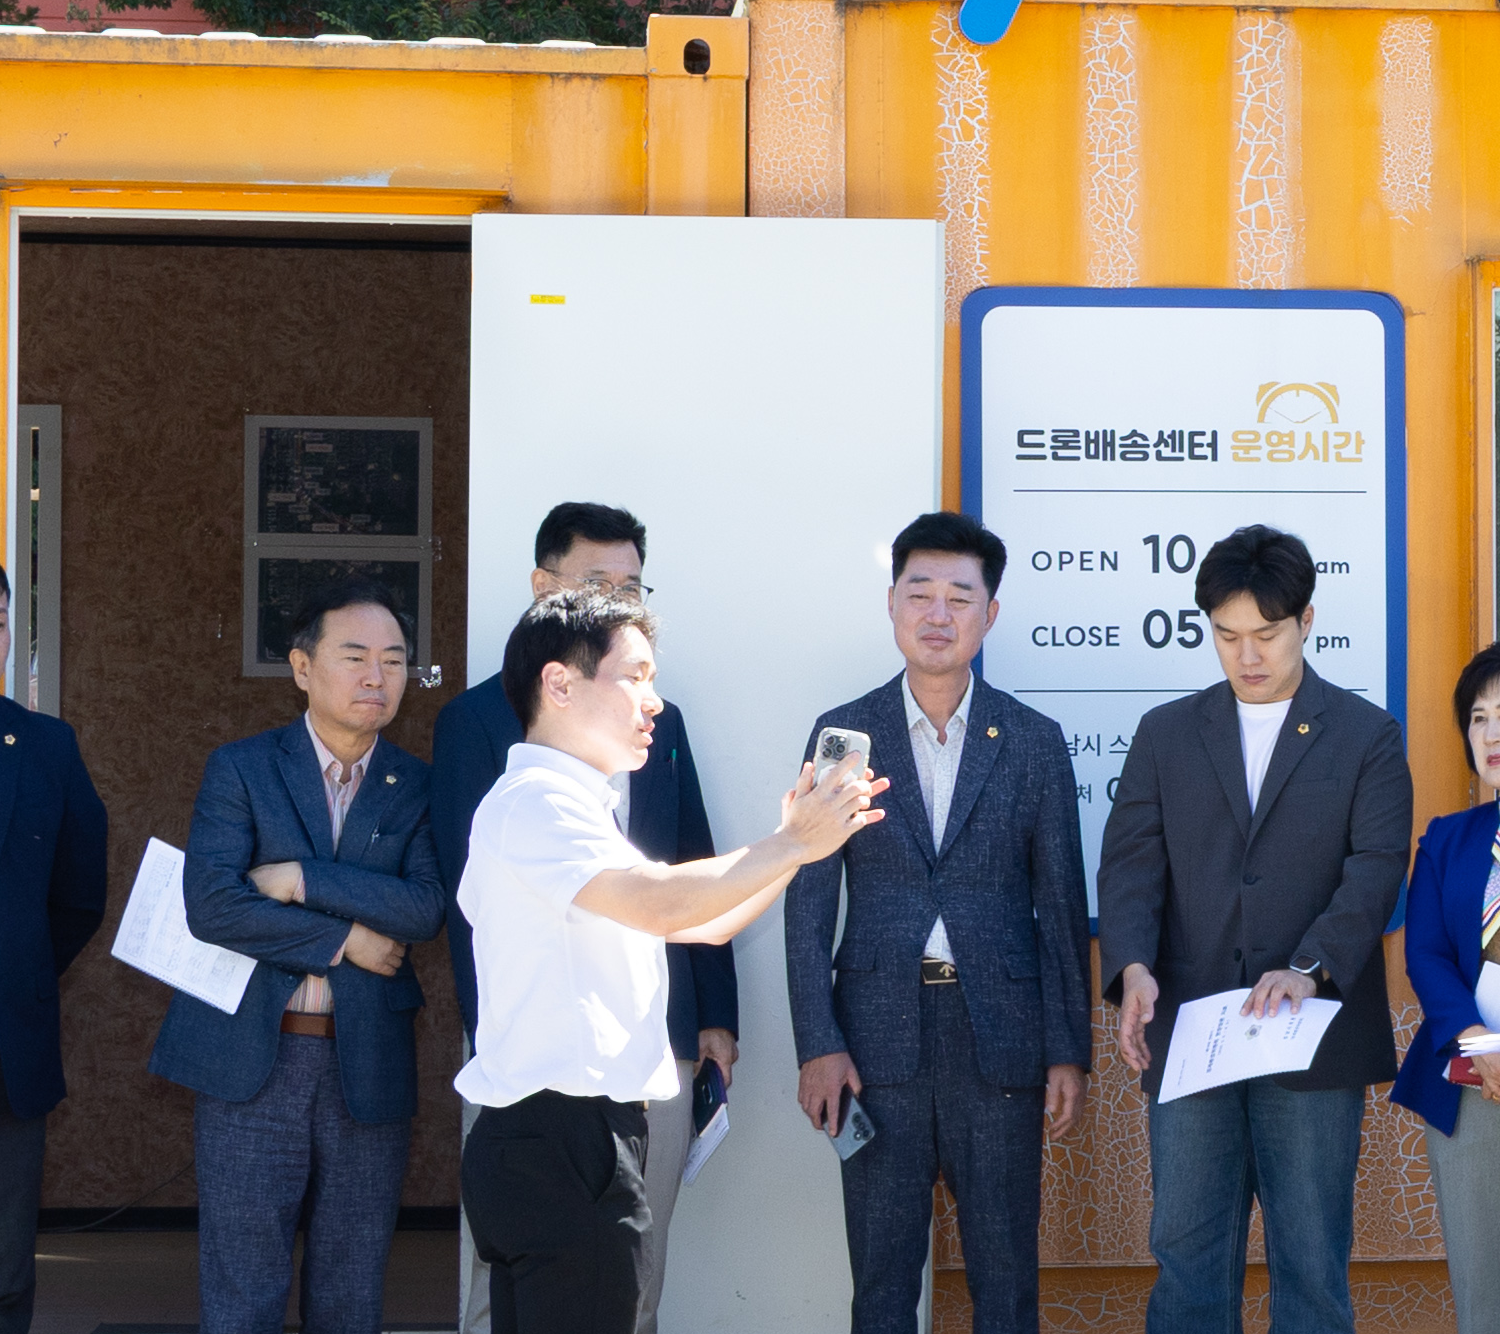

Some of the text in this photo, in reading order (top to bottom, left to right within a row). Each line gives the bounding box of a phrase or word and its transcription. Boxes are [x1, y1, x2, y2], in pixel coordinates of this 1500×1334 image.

[1016, 429, 1364, 462] 드론배송센터 운영시간
[1032, 532, 1351, 575] OPEN 10 am
[1032, 607, 1352, 654] CLOSE 05 pm
